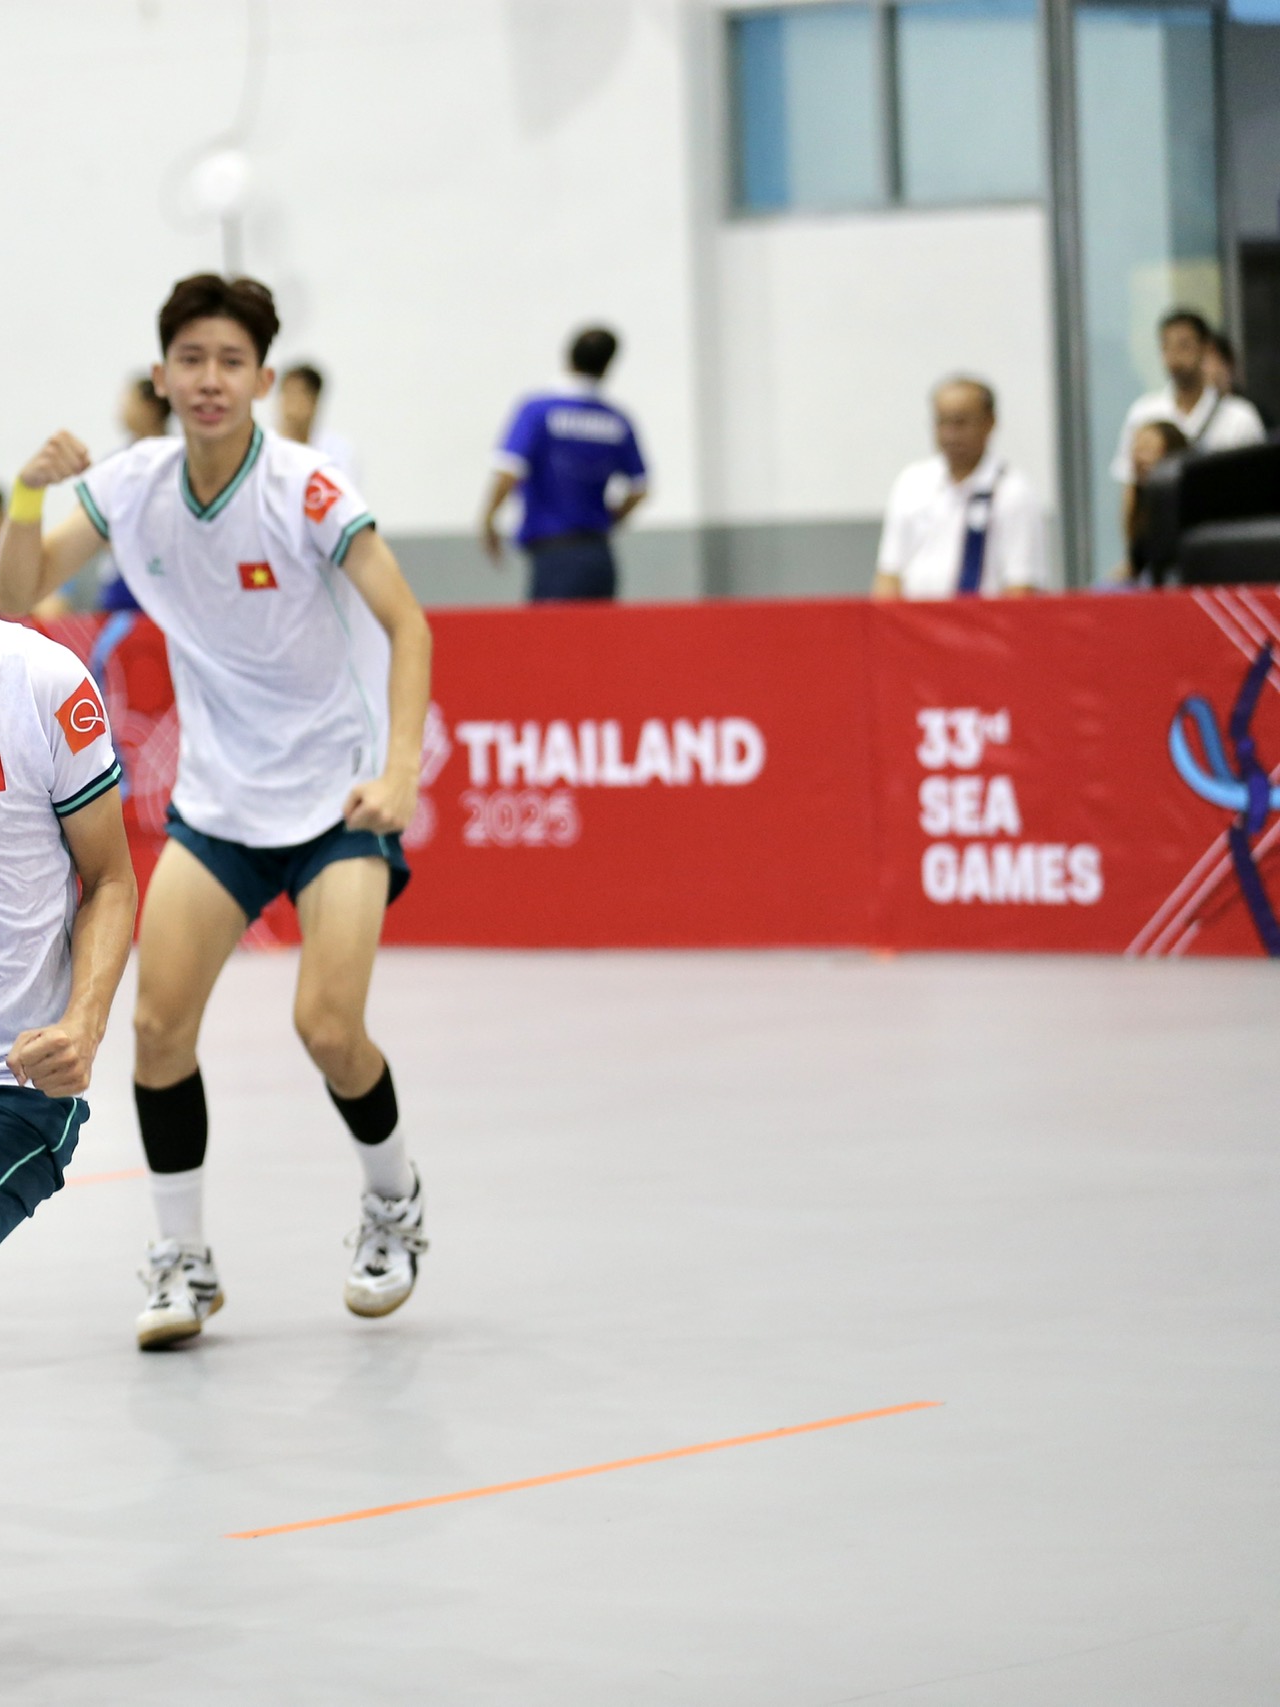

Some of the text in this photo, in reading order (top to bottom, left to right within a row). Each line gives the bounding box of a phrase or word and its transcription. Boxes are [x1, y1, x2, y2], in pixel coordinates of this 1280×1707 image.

[456, 717, 766, 787] THAILAND
[916, 707, 1010, 770] 33rd
[460, 788, 581, 848] 2025
[918, 774, 1023, 838] SEA
[921, 841, 1104, 906] GAMES
